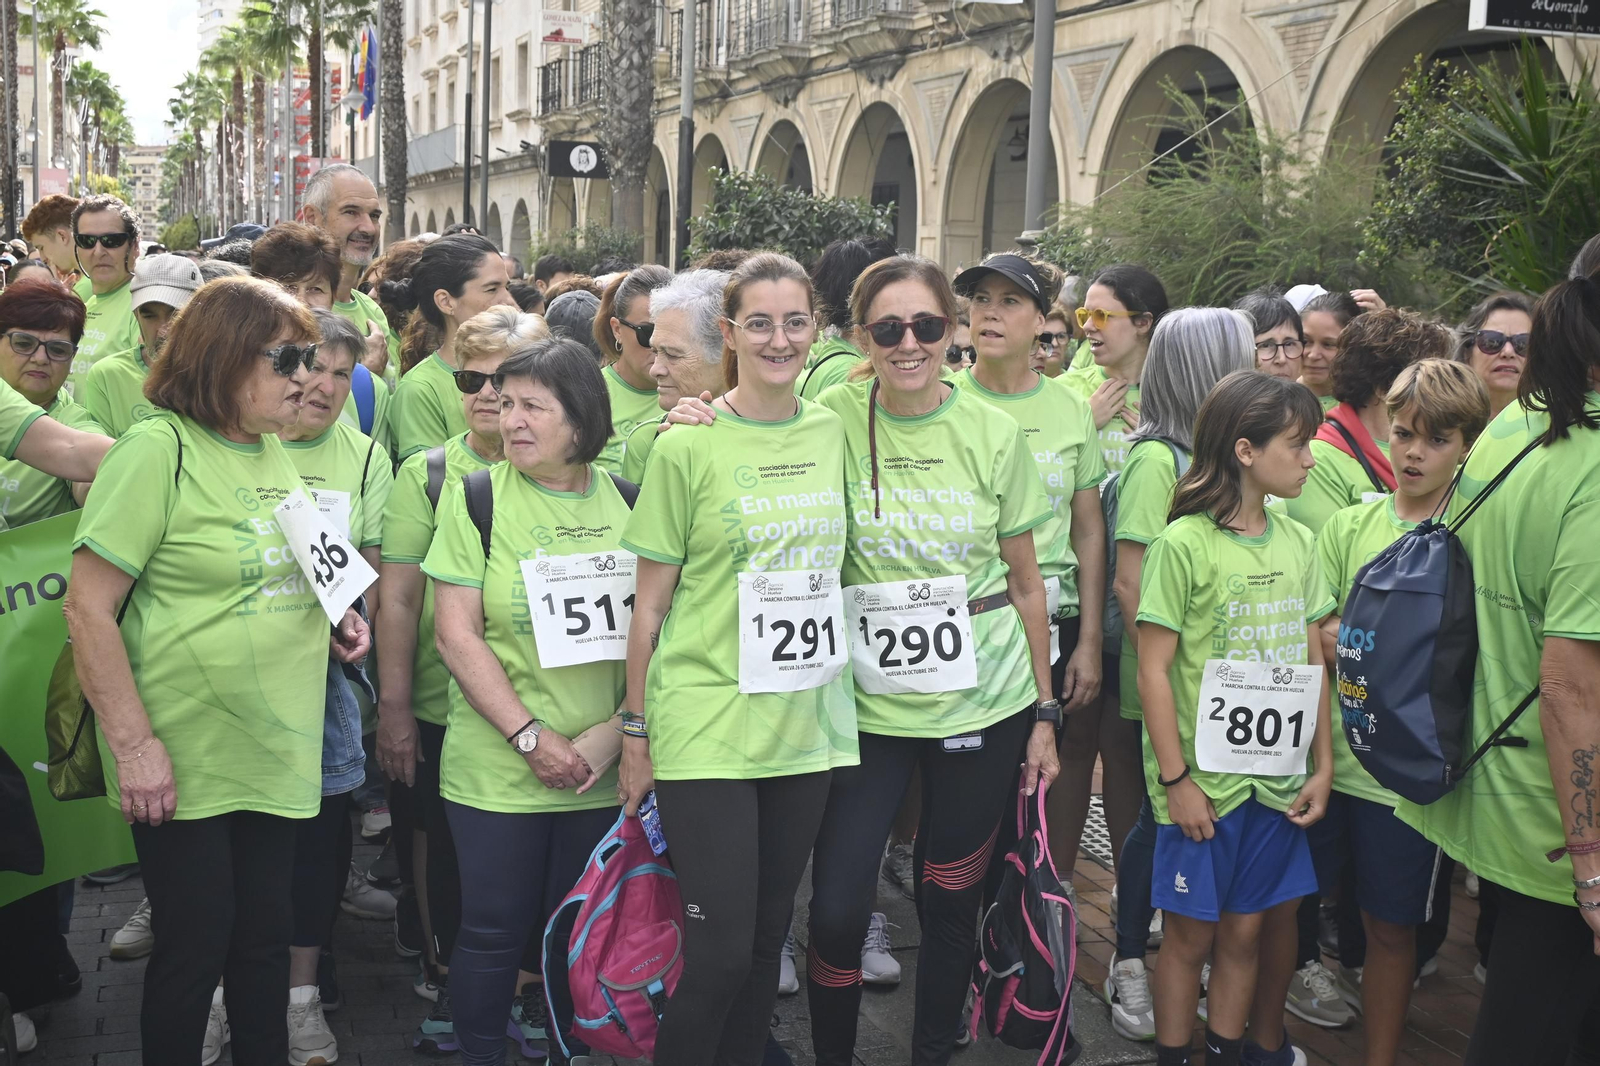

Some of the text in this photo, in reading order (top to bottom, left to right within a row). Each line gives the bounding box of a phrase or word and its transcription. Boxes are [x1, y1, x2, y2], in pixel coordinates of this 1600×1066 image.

[758, 462, 816, 472] asociación española
[910, 463, 931, 471] cáncer
[915, 458, 944, 466] española
[787, 469, 807, 477] cáncer
[1047, 469, 1064, 488] el
[740, 486, 844, 516] En marcha
[860, 480, 976, 506] En marcha
[747, 512, 844, 543] contra el
[855, 508, 976, 534] contra el
[856, 529, 976, 562] cáncer
[748, 541, 843, 572] cáncer
[549, 576, 568, 584] MARCHA
[904, 602, 922, 610] CÁNCER
[1228, 600, 1250, 618] En
[1287, 615, 1306, 636] el
[752, 613, 836, 662] 1291
[1337, 623, 1376, 652] MOS
[1226, 642, 1306, 664] cáncer
[908, 668, 927, 676] OCTUBRE
[1209, 696, 1304, 748] 2801
